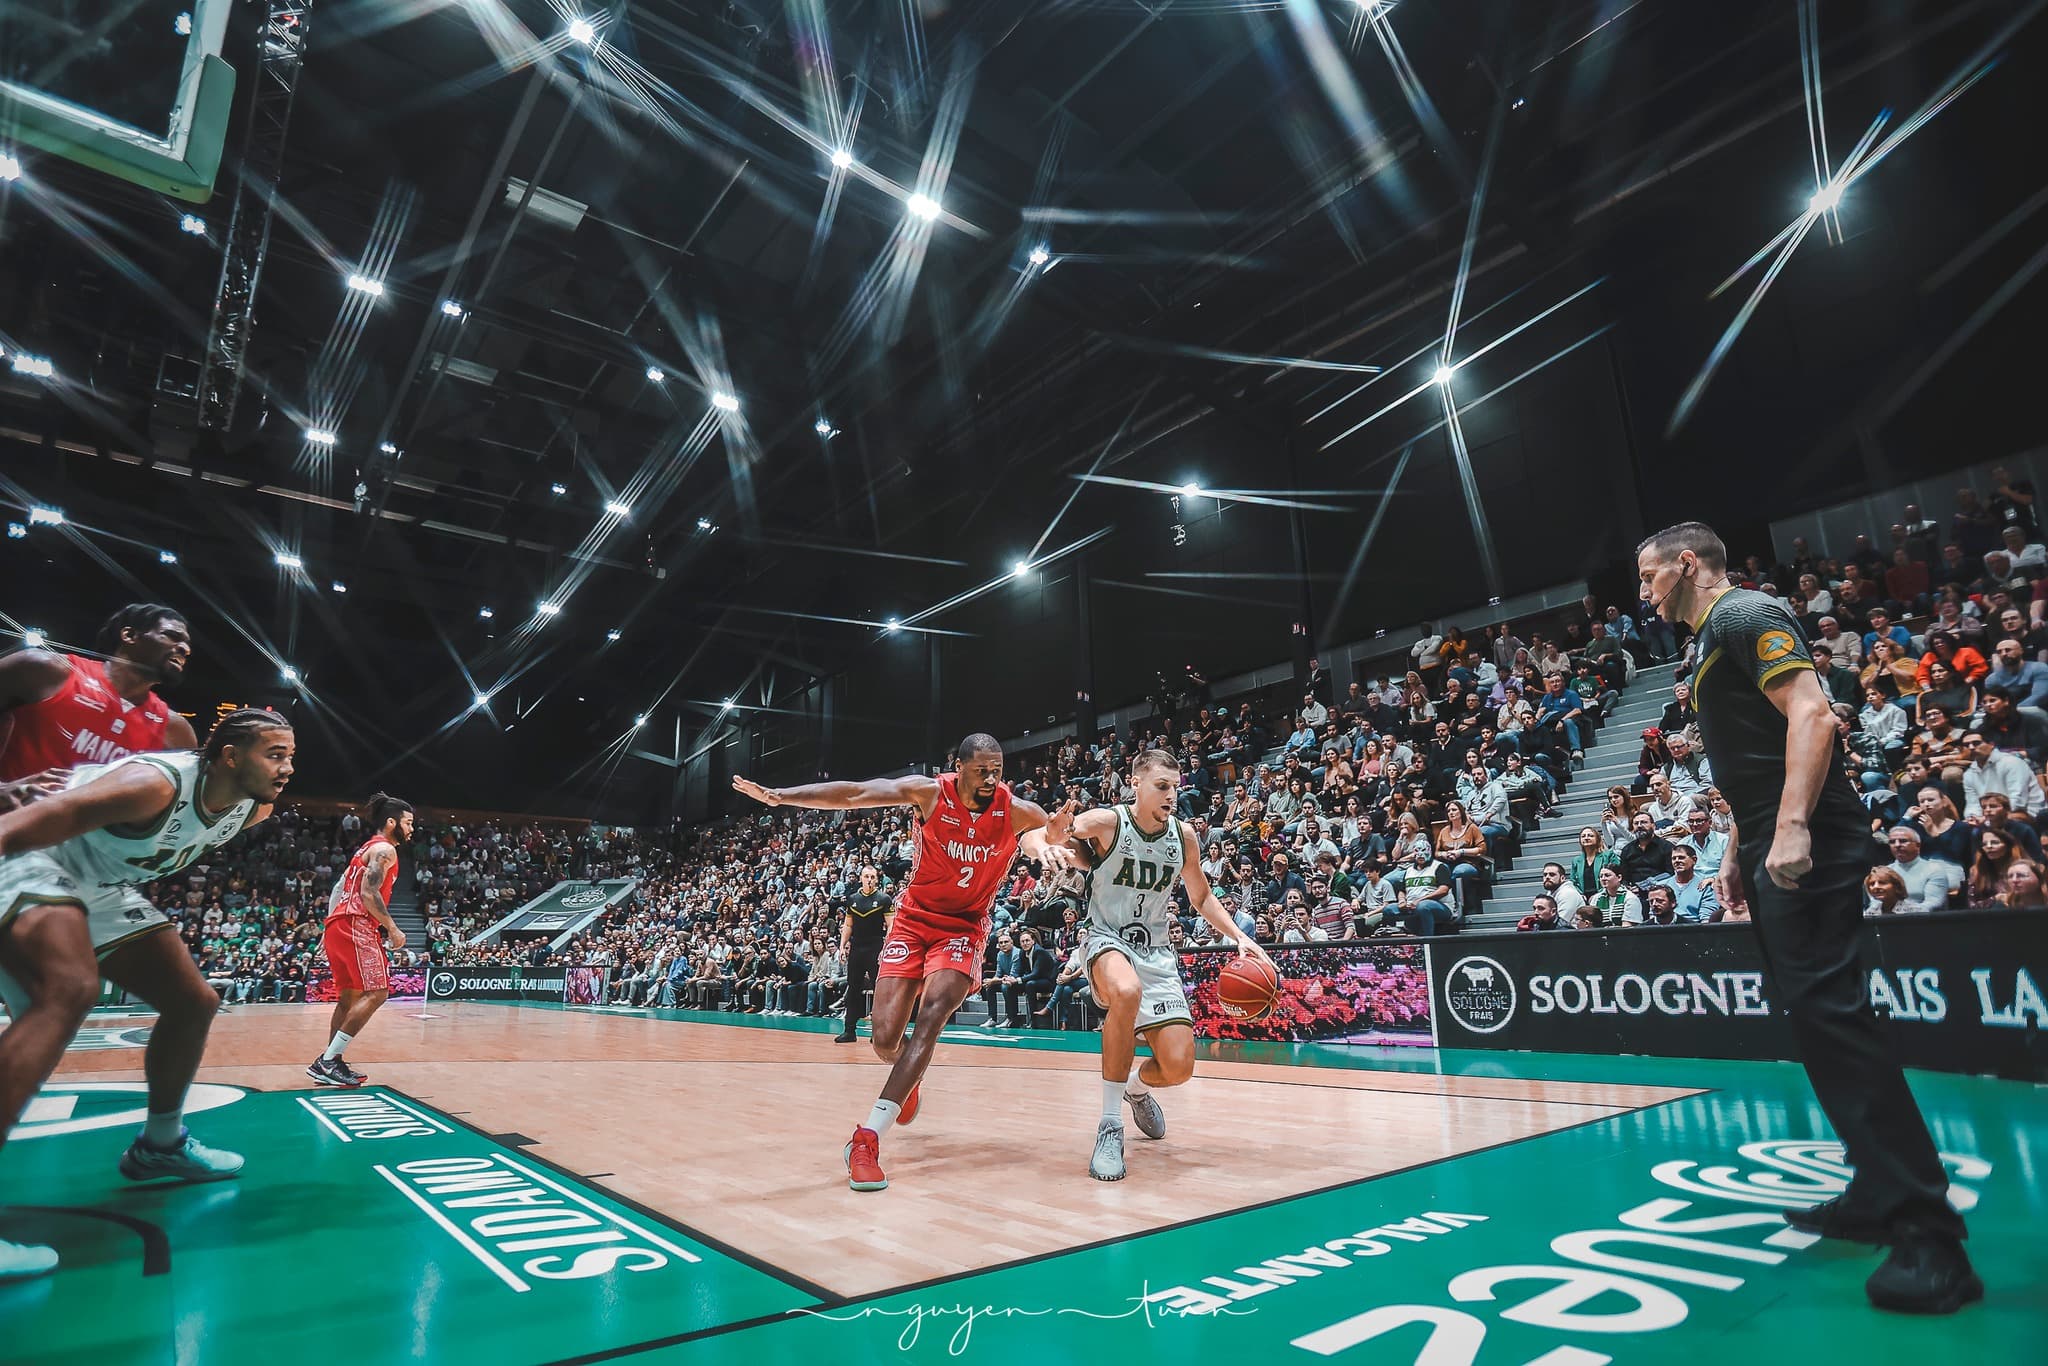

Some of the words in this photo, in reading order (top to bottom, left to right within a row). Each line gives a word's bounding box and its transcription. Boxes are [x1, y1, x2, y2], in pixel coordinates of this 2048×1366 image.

[71, 729, 146, 764] NANC
[947, 840, 991, 862] NANCY
[957, 867, 974, 888] 2
[1133, 893, 1146, 918] 3
[459, 978, 512, 991] SOLOGNE
[1452, 995, 1509, 1010] SOLOGNE
[1529, 965, 1770, 1016] SOLOGNE
[1868, 967, 1947, 1024] AIS
[1970, 967, 2048, 1031] LA
[1469, 1011, 1494, 1021] FRAIS
[310, 1094, 437, 1139] SIDAMO
[396, 1157, 668, 1280] SIDAMO
[1148, 1211, 1490, 1313] VALCANTE
